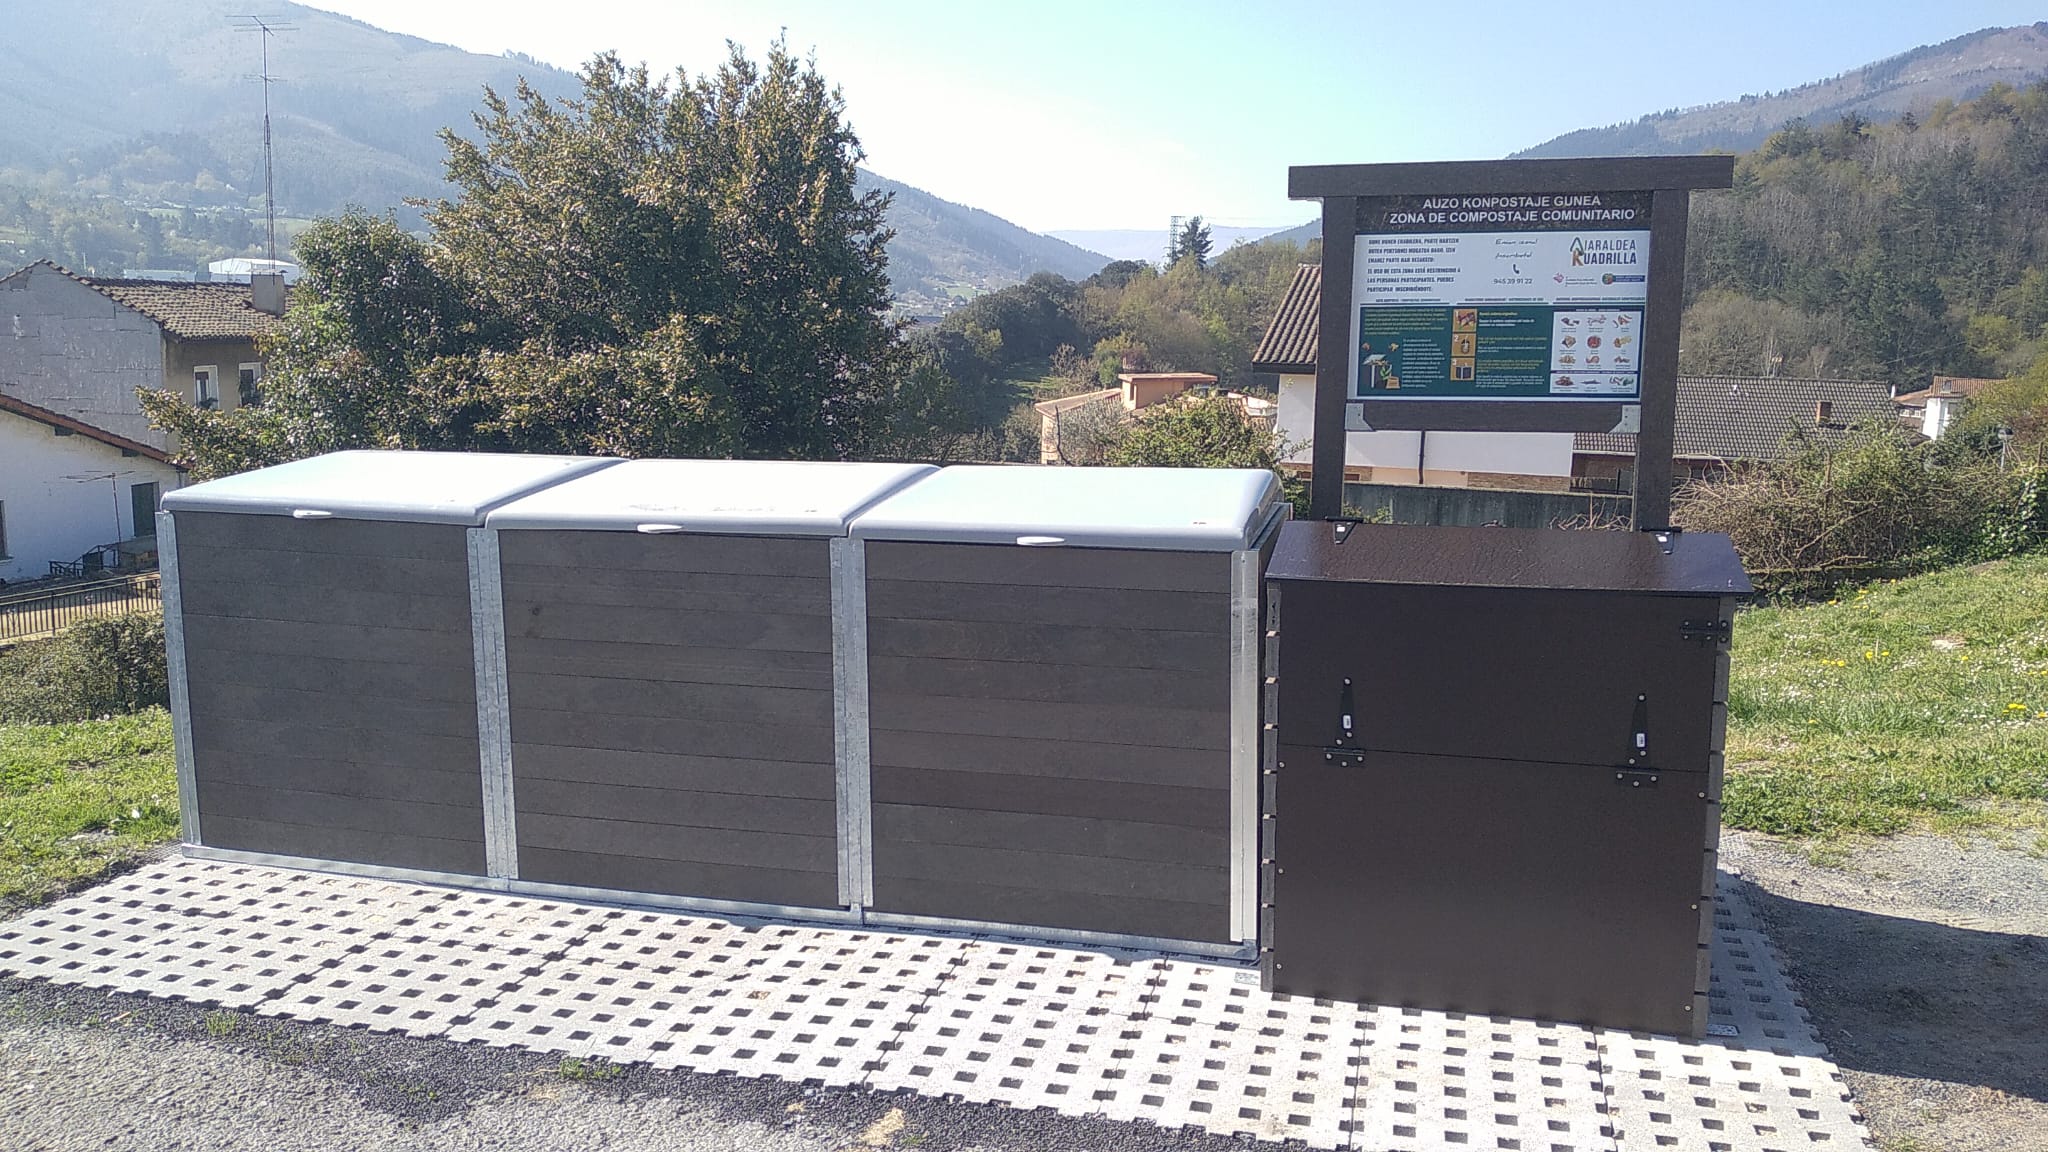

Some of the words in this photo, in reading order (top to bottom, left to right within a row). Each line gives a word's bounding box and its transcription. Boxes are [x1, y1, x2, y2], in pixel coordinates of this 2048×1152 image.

[1423, 198, 1459, 209] AUZO
[1462, 196, 1550, 209] KONPOSTAJE
[1553, 195, 1601, 207] GUNEA
[1390, 213, 1425, 224] ZONA
[1428, 212, 1446, 223] DE
[1449, 210, 1538, 223] COMPOSTAJE
[1541, 208, 1635, 221] COMUNITARIO
